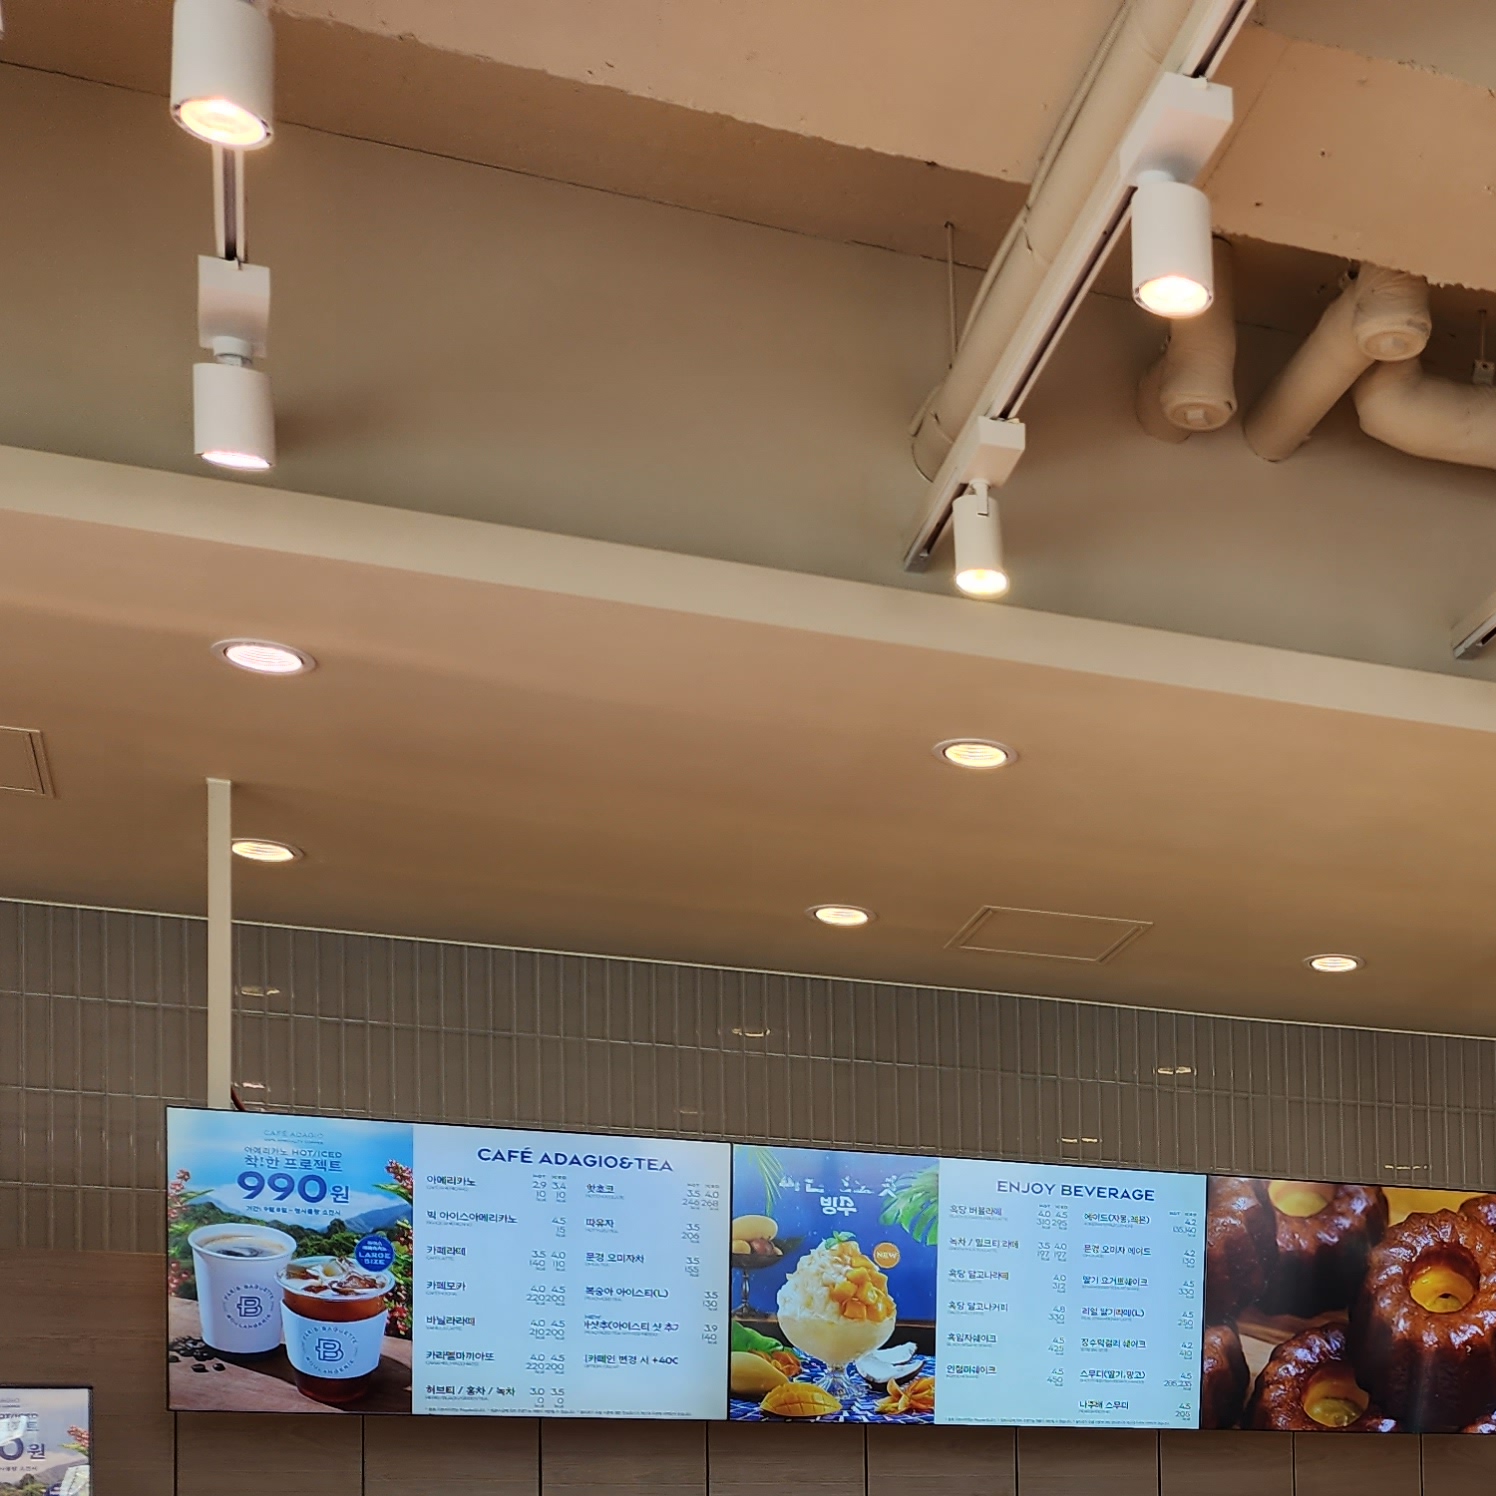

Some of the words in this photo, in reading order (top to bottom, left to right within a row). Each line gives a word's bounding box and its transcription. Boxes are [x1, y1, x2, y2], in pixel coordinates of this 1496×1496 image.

[291, 1149, 342, 1159] HOT/ICED
[476, 1145, 534, 1164] CAFÉ
[538, 1151, 674, 1173] ADAGIO&TEA
[285, 1158, 343, 1173] 프로젝트
[426, 1175, 476, 1188] 아메리카노
[532, 1181, 547, 1190] 2.9
[552, 1181, 567, 1190] 3.4
[237, 1171, 350, 1205] 990원
[997, 1180, 1056, 1196] ENJOY
[1061, 1185, 1155, 1202] BEVERAGE
[687, 1190, 701, 1199] 3.5
[705, 1190, 720, 1199] 4.0
[439, 1212, 518, 1224] 아이스아메리카노
[552, 1217, 567, 1226] 4.5
[686, 1223, 700, 1231] 3.5
[426, 1246, 466, 1257] 카페라떼
[532, 1250, 546, 1259] 3.5
[551, 1251, 566, 1259] 4.0
[607, 1253, 645, 1264] 오미자차
[426, 1281, 466, 1292] 카페모카
[530, 1285, 546, 1294] 4.0
[551, 1286, 566, 1294] 4.5
[704, 1290, 719, 1300] 3.5
[426, 1315, 475, 1326] 바닐라라떼
[530, 1319, 546, 1328] 4.0
[551, 1319, 566, 1328] 4.5
[704, 1324, 719, 1333] 3.9
[426, 1350, 495, 1362] 카라멜마끼아또
[530, 1353, 546, 1362] 4.0
[551, 1353, 566, 1362] 4.5
[425, 1386, 456, 1396] 허브티
[466, 1385, 486, 1396] 홍차
[496, 1386, 516, 1397] 녹차
[530, 1388, 545, 1397] 3.0
[551, 1388, 565, 1397] 3.5
